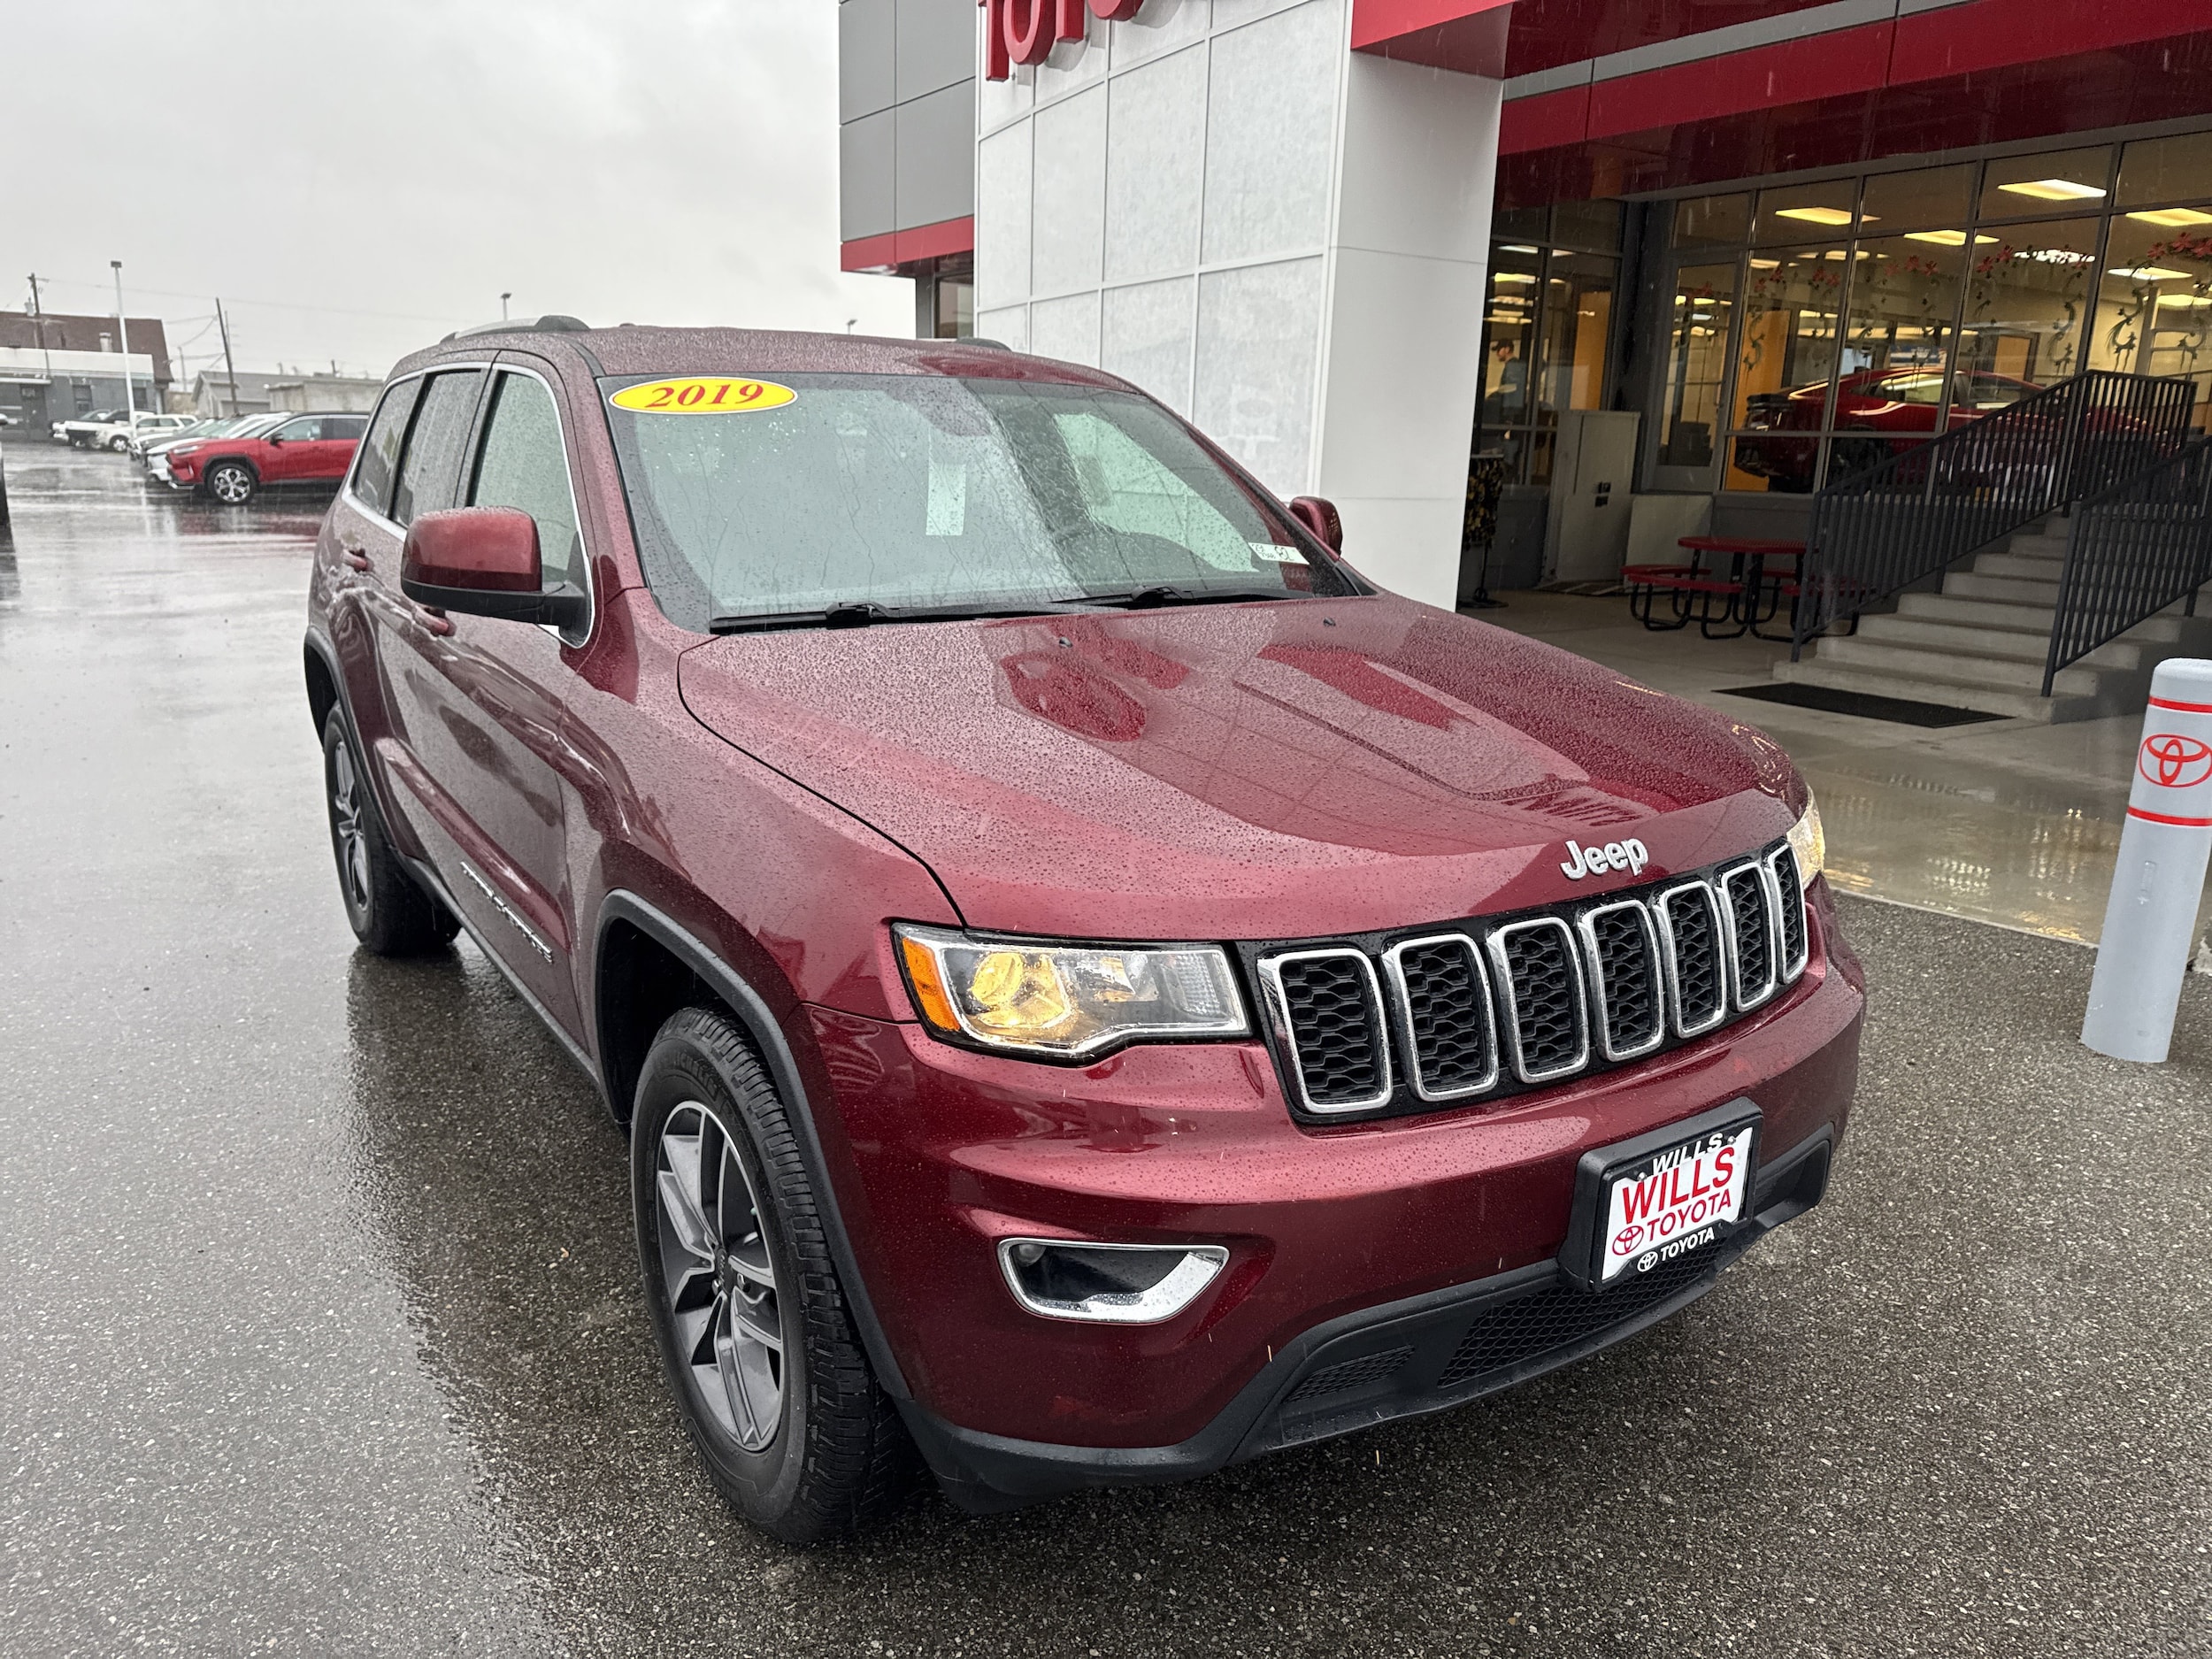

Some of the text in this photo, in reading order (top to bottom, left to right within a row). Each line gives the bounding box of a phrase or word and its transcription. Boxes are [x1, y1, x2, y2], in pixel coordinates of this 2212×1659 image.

[644, 384, 764, 408] 2019
[1560, 839, 1648, 879] Jeep
[1653, 1133, 1723, 1175] WILLS
[1623, 1147, 1734, 1225] WILLS
[1647, 1189, 1732, 1241] TOYOTA
[1661, 1227, 1714, 1261] TOYOTA
